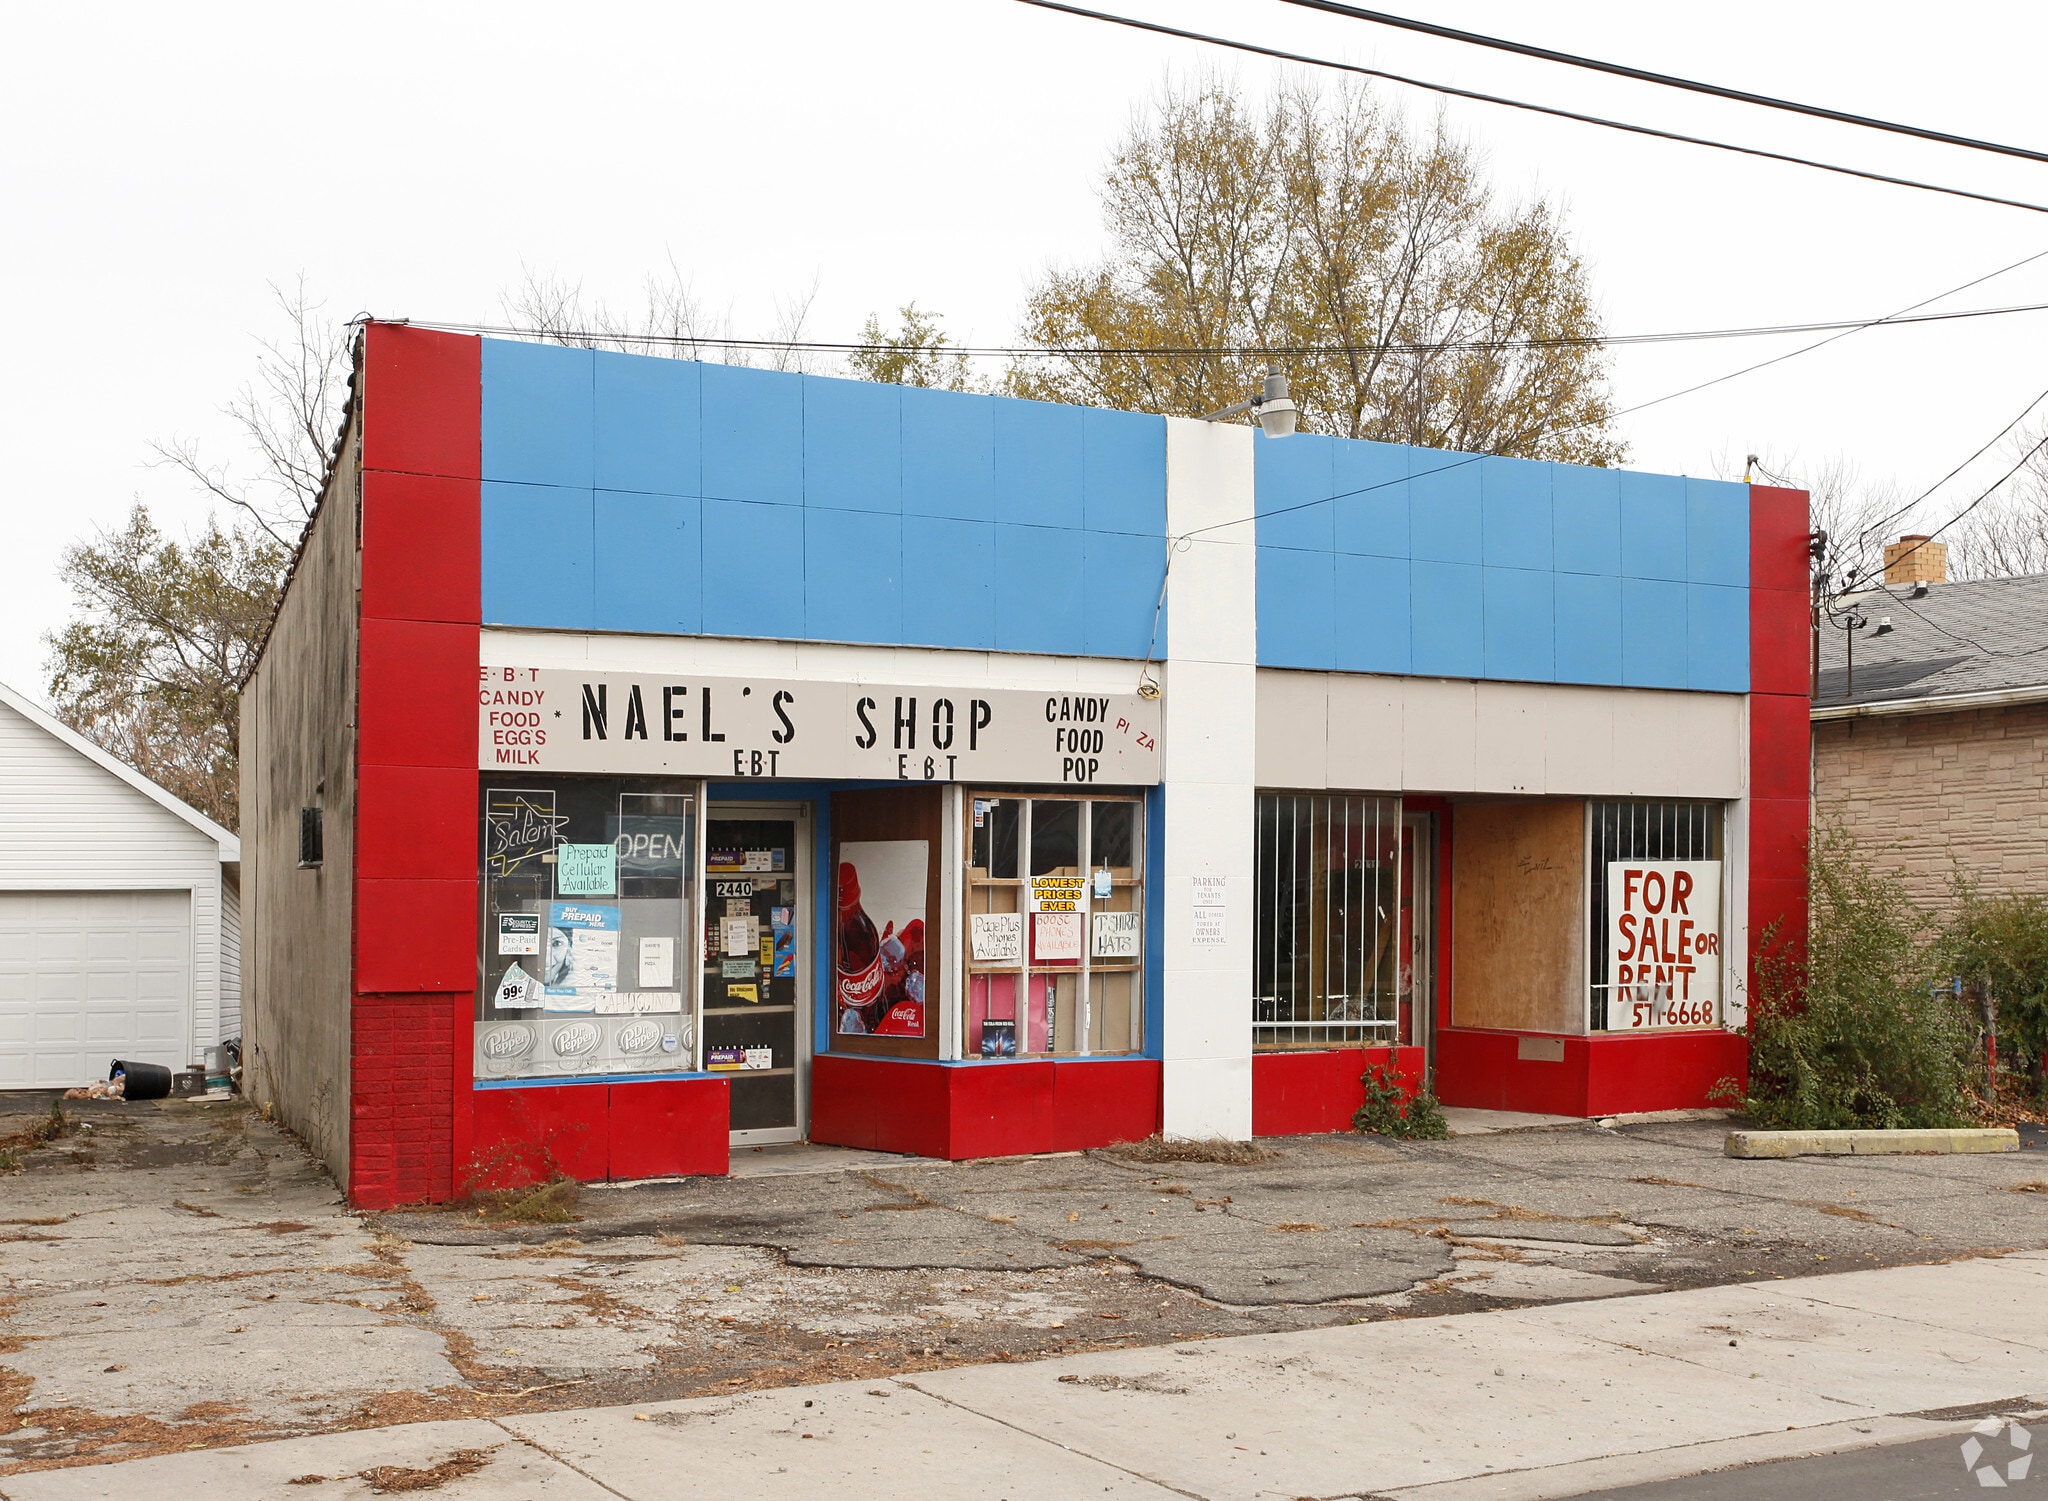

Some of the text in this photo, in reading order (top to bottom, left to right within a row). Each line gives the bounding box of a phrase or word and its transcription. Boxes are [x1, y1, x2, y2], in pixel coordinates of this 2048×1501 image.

[479, 690, 545, 706] CANDY
[582, 683, 992, 750] NAEL'S SHOP
[1045, 697, 1110, 723] CANDY
[489, 711, 540, 727] FOOD
[1056, 727, 1104, 754] FOOD
[496, 748, 540, 764] MILK
[1063, 757, 1099, 782] POP
[566, 844, 609, 860] Prepaid
[613, 833, 685, 859] OPEN
[561, 862, 606, 877] Cellular
[562, 876, 610, 891] Available
[717, 883, 752, 896] 2440
[1031, 878, 1085, 888] LOWEST
[1192, 876, 1226, 887] PARKING
[1034, 890, 1082, 900] PRICES
[1623, 869, 1694, 915] FOR
[1040, 901, 1076, 911] EVER
[561, 912, 602, 922] PREPAID
[1193, 911, 1207, 919] ALL
[503, 935, 537, 944] Pre-Paid
[987, 930, 1016, 947] phones
[1195, 928, 1221, 936] OWNERS
[1617, 913, 1718, 964] SALE OR
[502, 945, 523, 953] Cards
[976, 942, 1018, 959] Available
[1097, 934, 1132, 955] HATS
[842, 962, 881, 994] Coca-Cola
[1617, 963, 1697, 1003] RENT
[503, 985, 523, 1000] 99¢
[891, 1008, 916, 1021] Coca-Cola
[501, 1029, 517, 1043] Dr
[570, 1026, 586, 1041] Dr
[621, 1028, 657, 1051] Pepper
[634, 1025, 647, 1038] Dr
[486, 1032, 528, 1055] Pepper
[556, 1029, 594, 1053] Pepper
